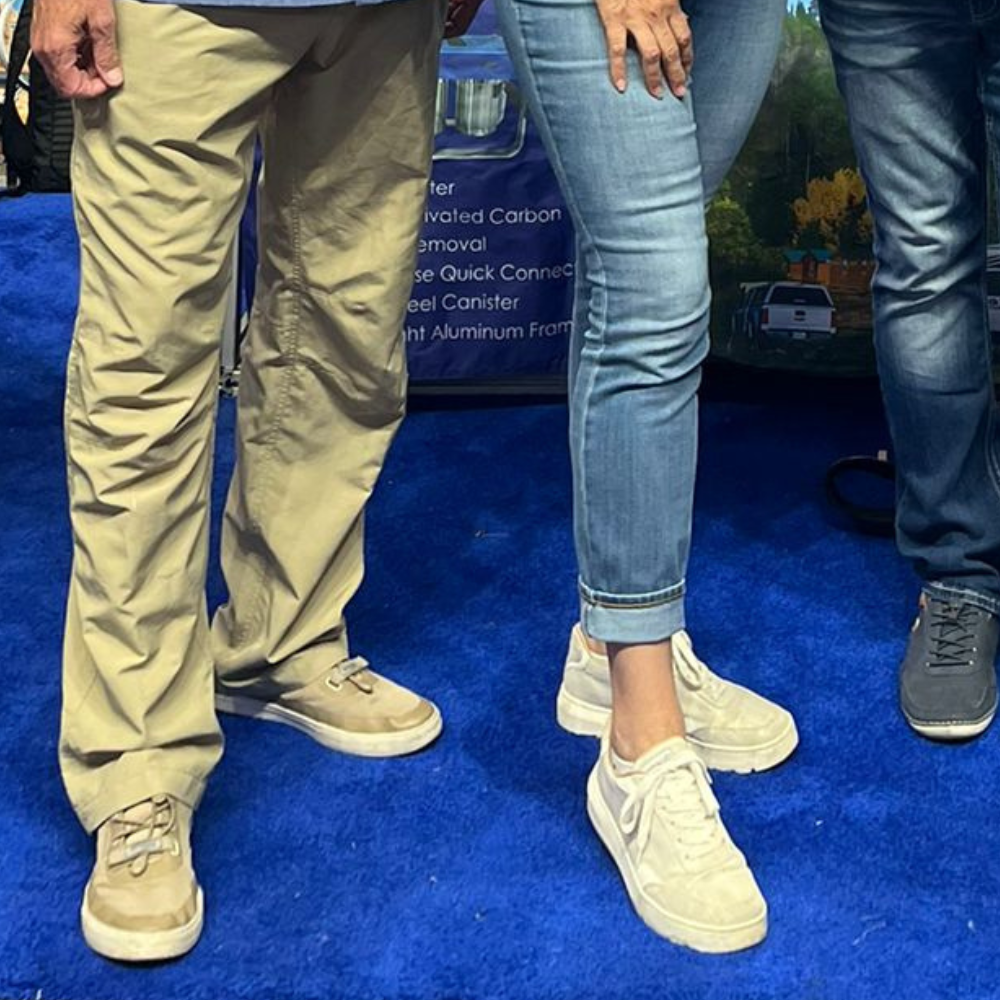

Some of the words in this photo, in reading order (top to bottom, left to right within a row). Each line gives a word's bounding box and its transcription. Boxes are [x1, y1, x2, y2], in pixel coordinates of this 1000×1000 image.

[430, 180, 456, 196] ter
[424, 208, 484, 224] ivated
[489, 207, 562, 225] Carbon
[418, 236, 488, 253] emoval
[414, 268, 435, 283] se
[439, 264, 495, 283] Quick
[499, 262, 575, 282] Connec
[406, 295, 437, 313] eel
[441, 293, 520, 311] Canister
[405, 324, 426, 342] ht
[430, 322, 524, 341] Aluminum
[529, 319, 575, 339] Fram
